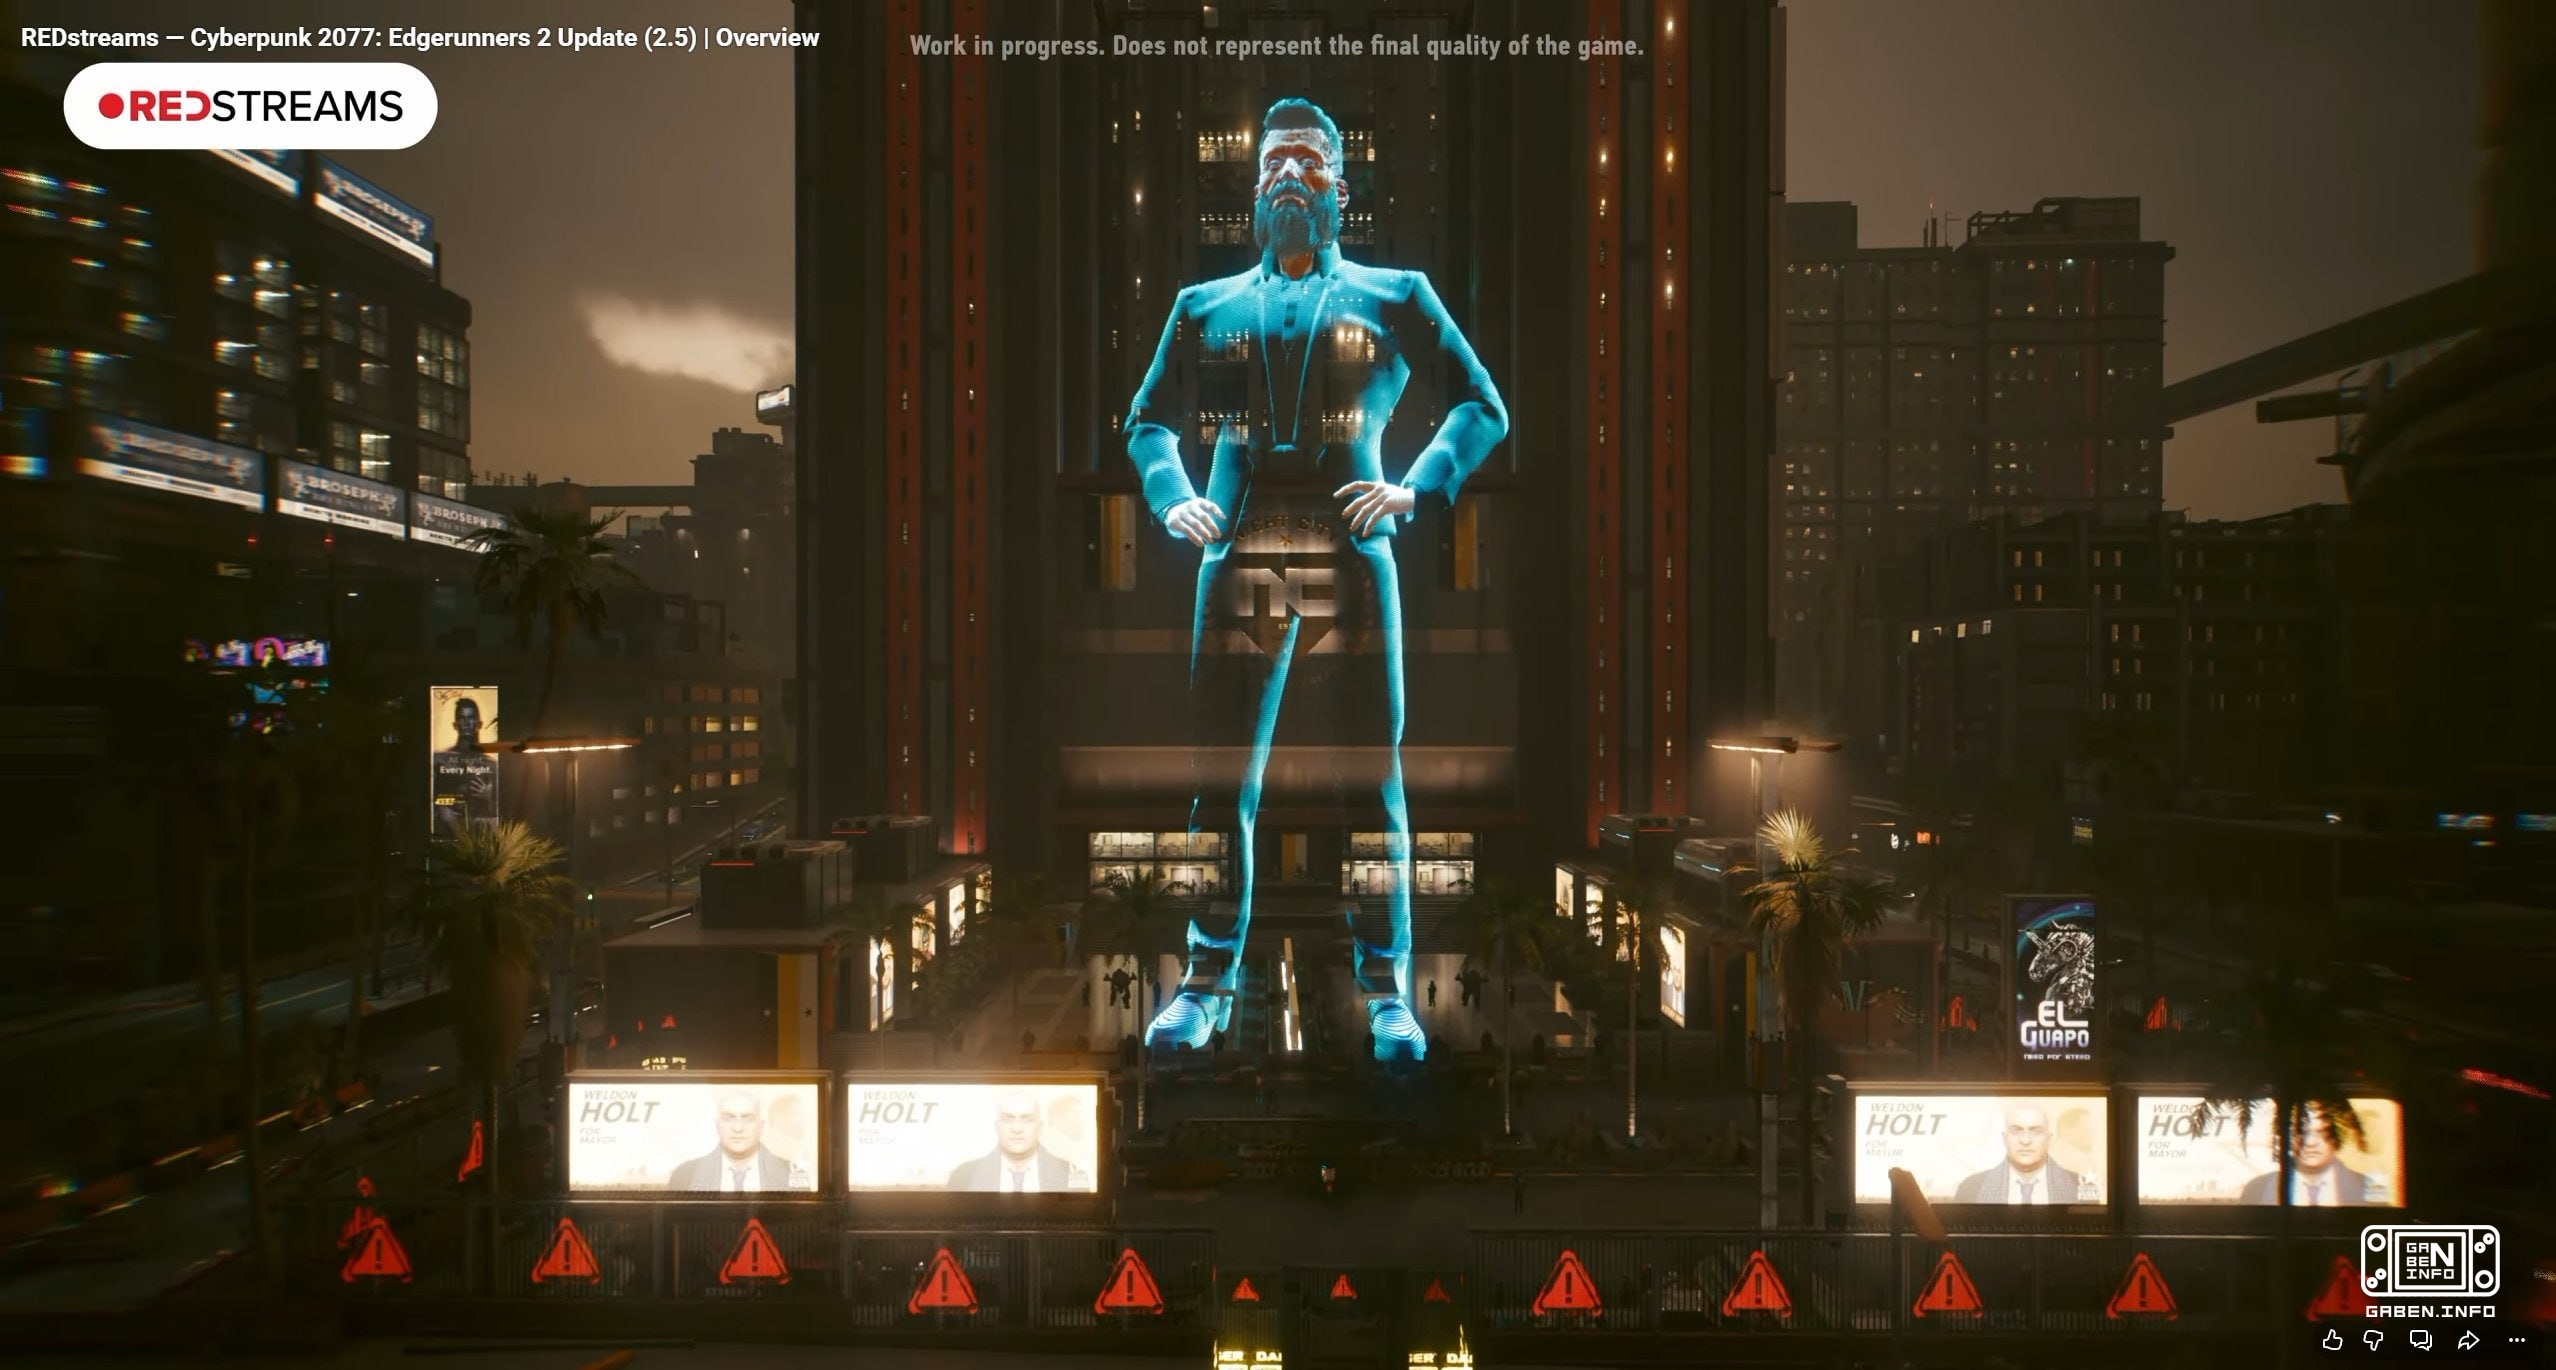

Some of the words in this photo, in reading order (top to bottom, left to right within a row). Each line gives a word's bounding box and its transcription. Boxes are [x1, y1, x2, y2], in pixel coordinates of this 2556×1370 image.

[440, 765, 464, 775] Every
[2038, 1000, 2089, 1028] EL
[584, 1091, 638, 1100] WELDON
[863, 1091, 916, 1100] WELDON
[580, 1101, 660, 1123] HOLT
[1871, 1103, 1924, 1112] WELDON
[859, 1102, 939, 1123] HOLT
[1866, 1114, 1947, 1135] HOLT
[2148, 1141, 2170, 1149] FOR
[2148, 1150, 2188, 1158] MAYOR
